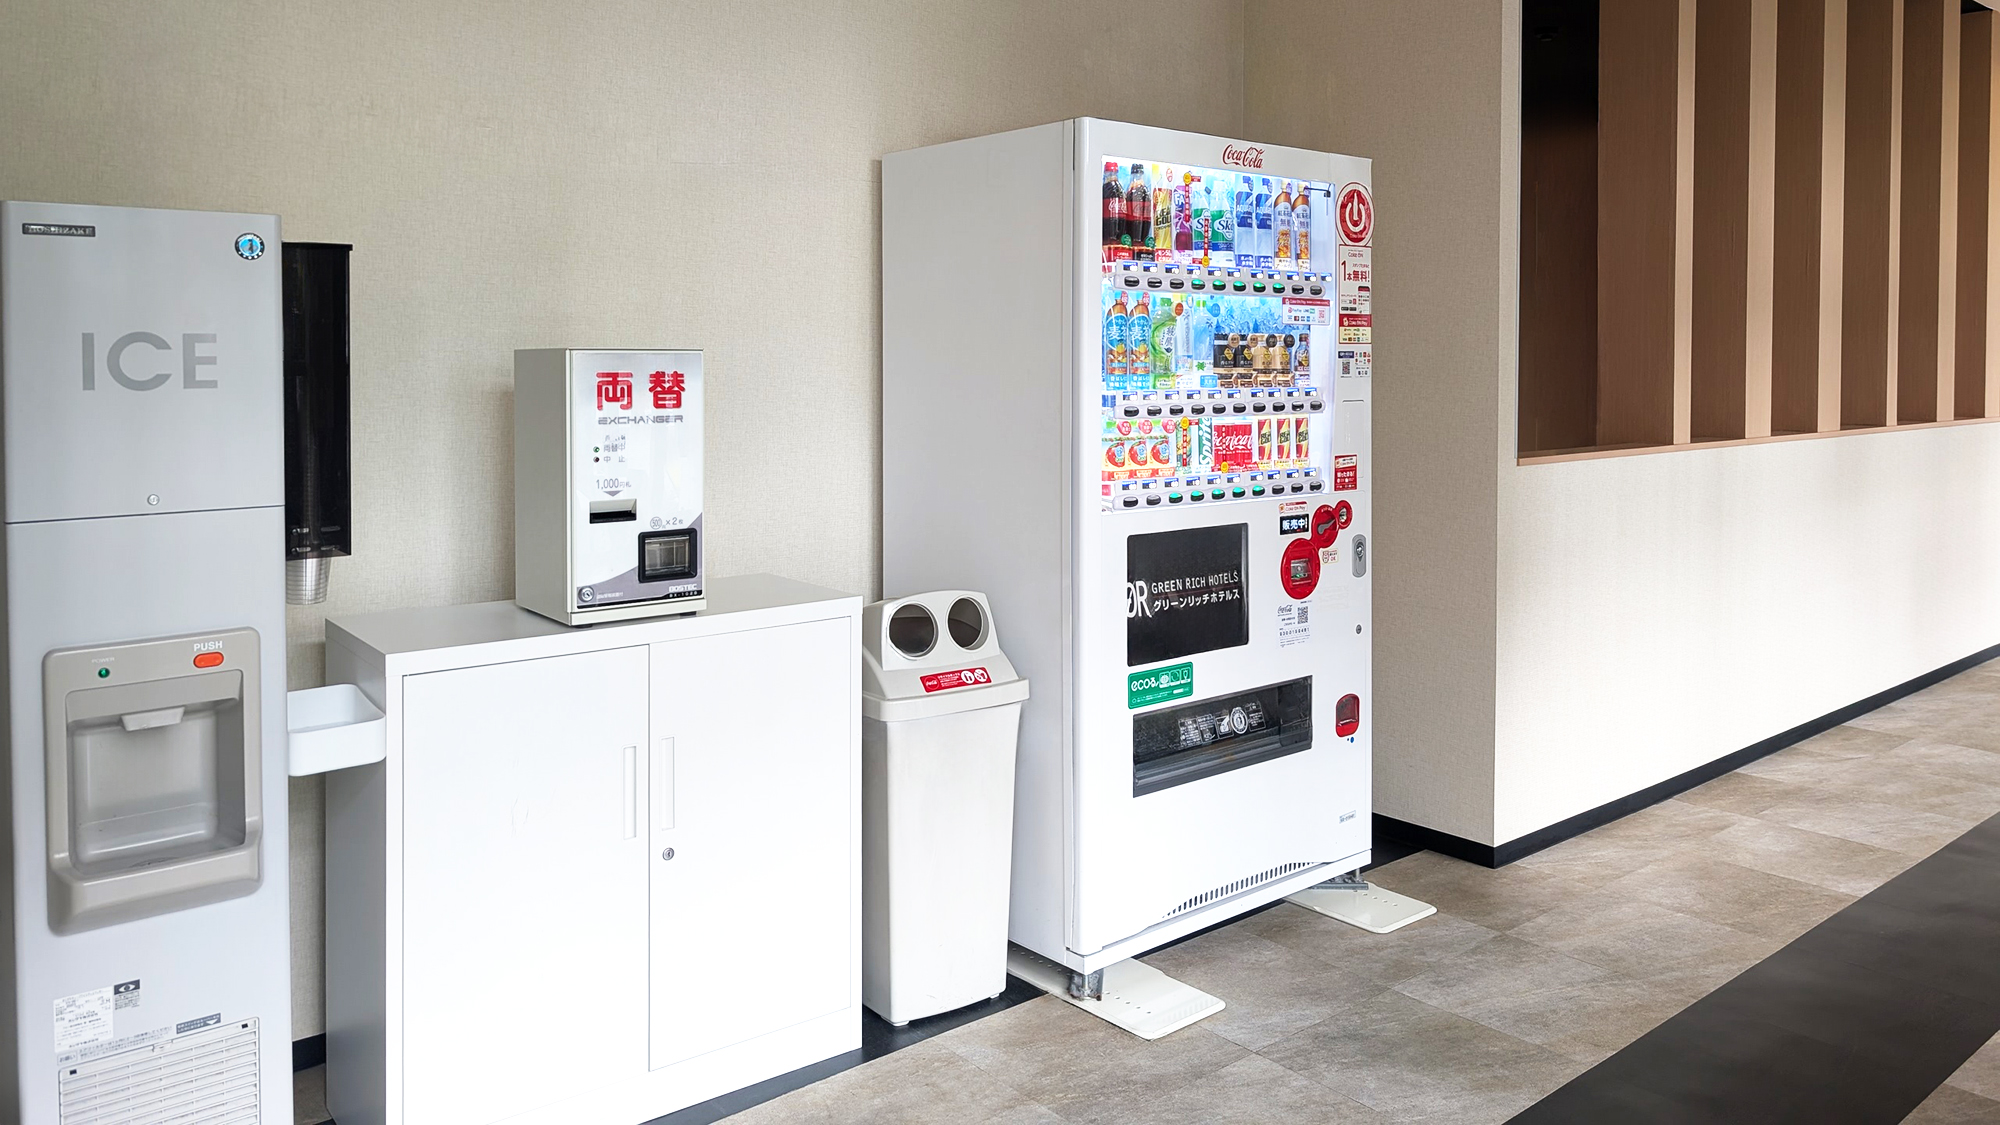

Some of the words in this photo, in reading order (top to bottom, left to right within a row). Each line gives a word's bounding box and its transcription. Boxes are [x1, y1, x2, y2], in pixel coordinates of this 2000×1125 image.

[1222, 143, 1265, 169] Coca-Cola
[82, 331, 218, 391] ICE
[596, 371, 686, 411] 両替
[598, 415, 684, 425] EXCHANGER
[603, 442, 626, 452] 両替中
[603, 455, 626, 463] 中止
[596, 478, 632, 490] 1,000円札
[1151, 579, 1182, 594] GREEN
[1185, 576, 1206, 590] RICH
[1208, 571, 1239, 586] HOTELS
[1153, 589, 1240, 612] グリーンリッチホテルス
[193, 640, 223, 652] PUSH
